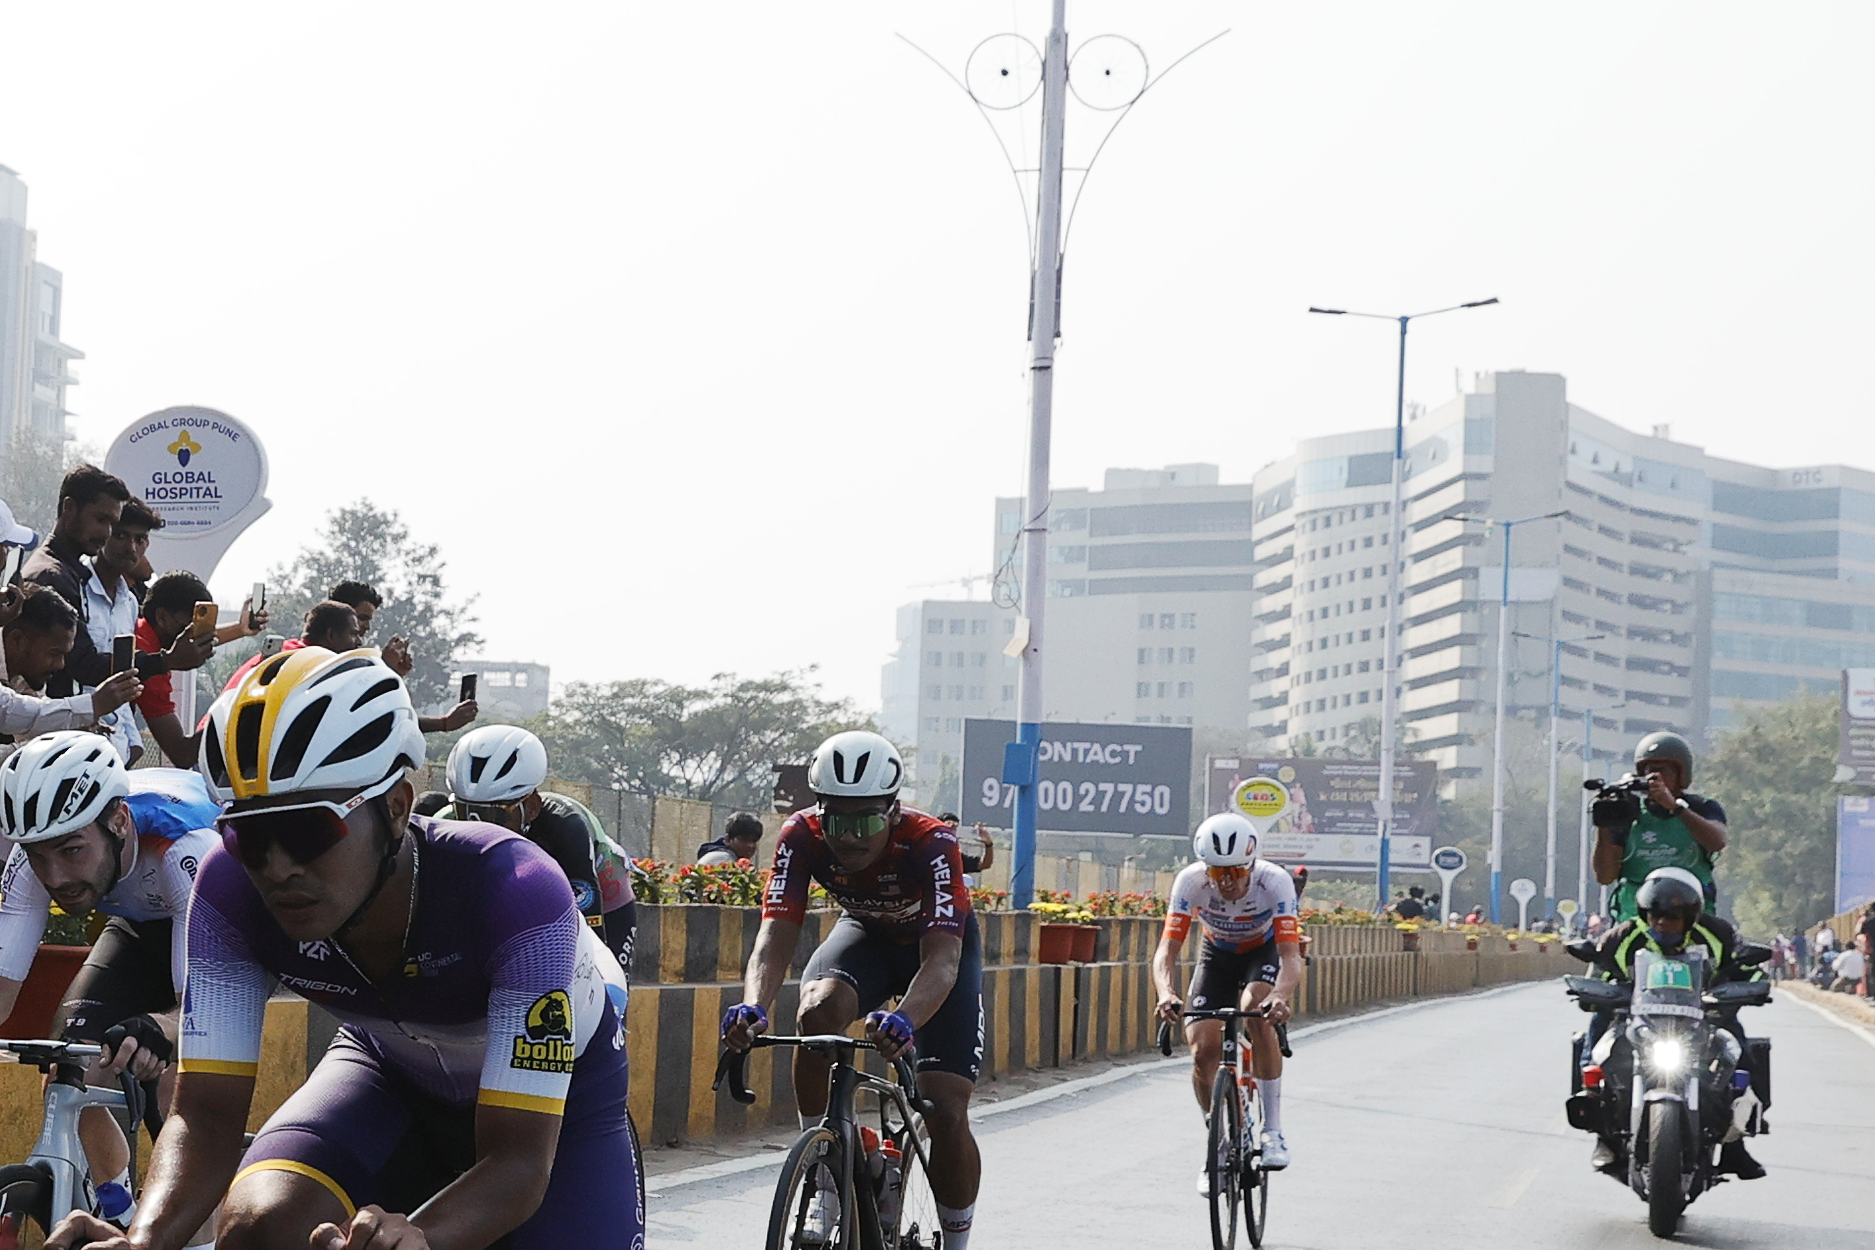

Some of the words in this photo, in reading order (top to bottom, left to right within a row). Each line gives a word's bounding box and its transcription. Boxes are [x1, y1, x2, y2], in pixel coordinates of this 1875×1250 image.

[129, 419, 169, 443] GLOBAL
[171, 417, 210, 428] GROUP
[211, 421, 241, 443] PUNE
[151, 471, 216, 484] GLOBAL
[145, 486, 223, 500] HOSPITAL
[1037, 740, 1144, 765] ONTACT
[64, 768, 90, 815] MET
[981, 776, 1074, 811] 9700
[1078, 781, 1171, 815] 27750
[929, 854, 954, 918] HELAZ
[279, 972, 358, 996] TRIGON
[513, 1059, 563, 1072] ENERGY
[42, 1091, 58, 1146] CUBE
